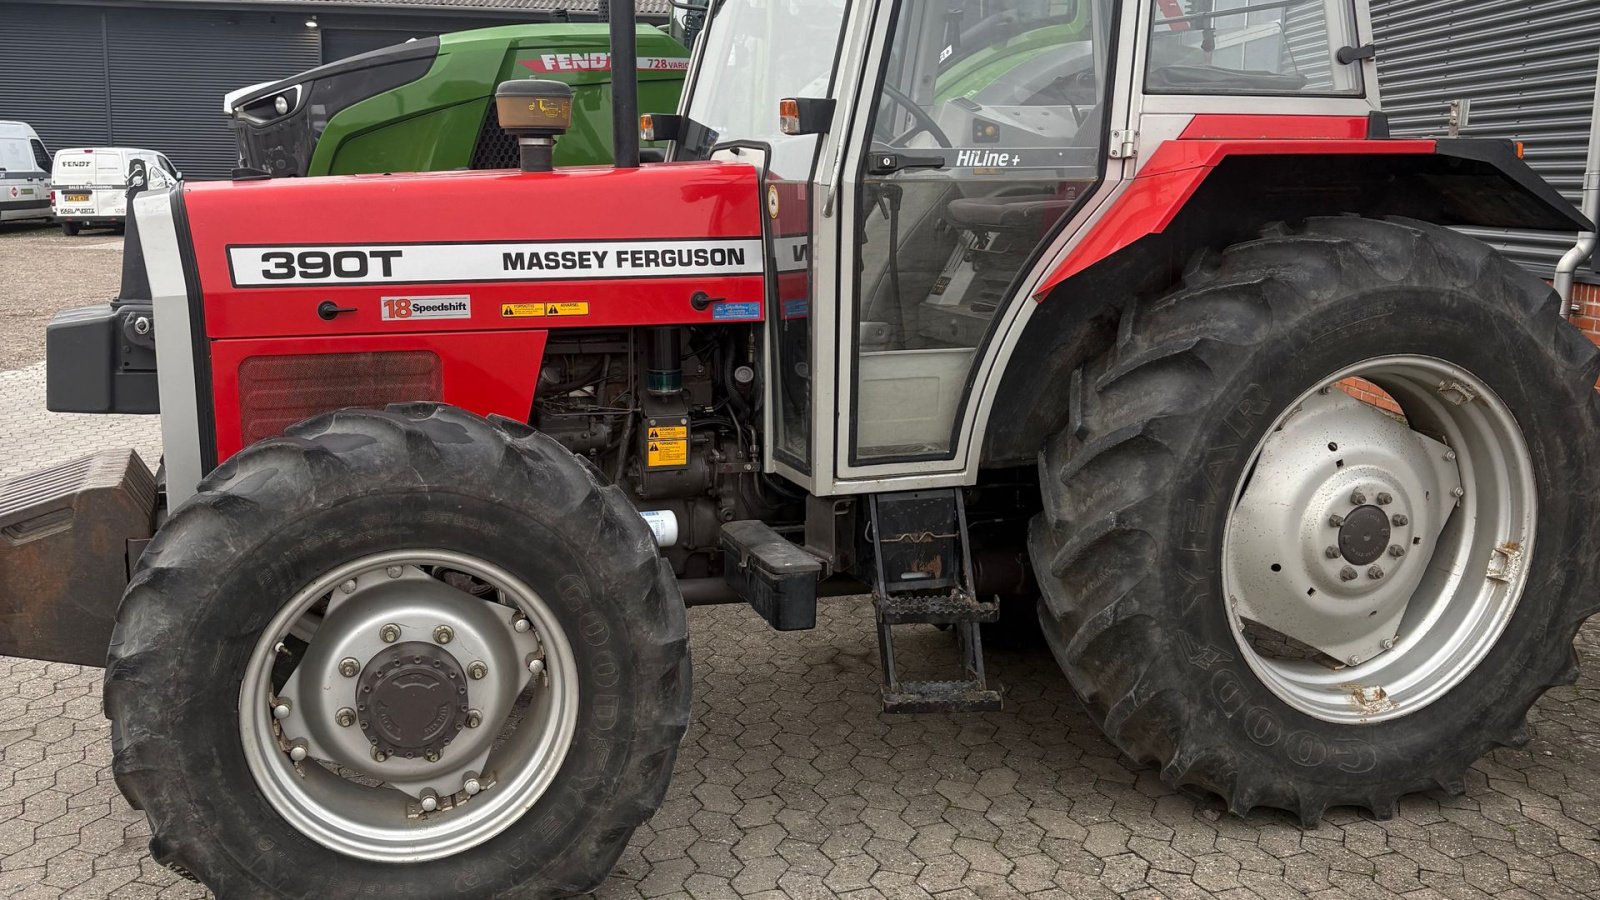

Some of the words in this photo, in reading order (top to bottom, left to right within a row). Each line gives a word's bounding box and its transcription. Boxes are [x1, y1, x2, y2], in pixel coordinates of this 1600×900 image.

[540, 52, 612, 70] FEND
[647, 58, 667, 69] 728
[956, 149, 1009, 167] HiLine
[261, 250, 403, 280] 390T
[502, 250, 609, 271] MASSEY
[616, 248, 745, 268] FERGUSON
[383, 298, 413, 319] 18
[412, 301, 467, 313] Speedshift
